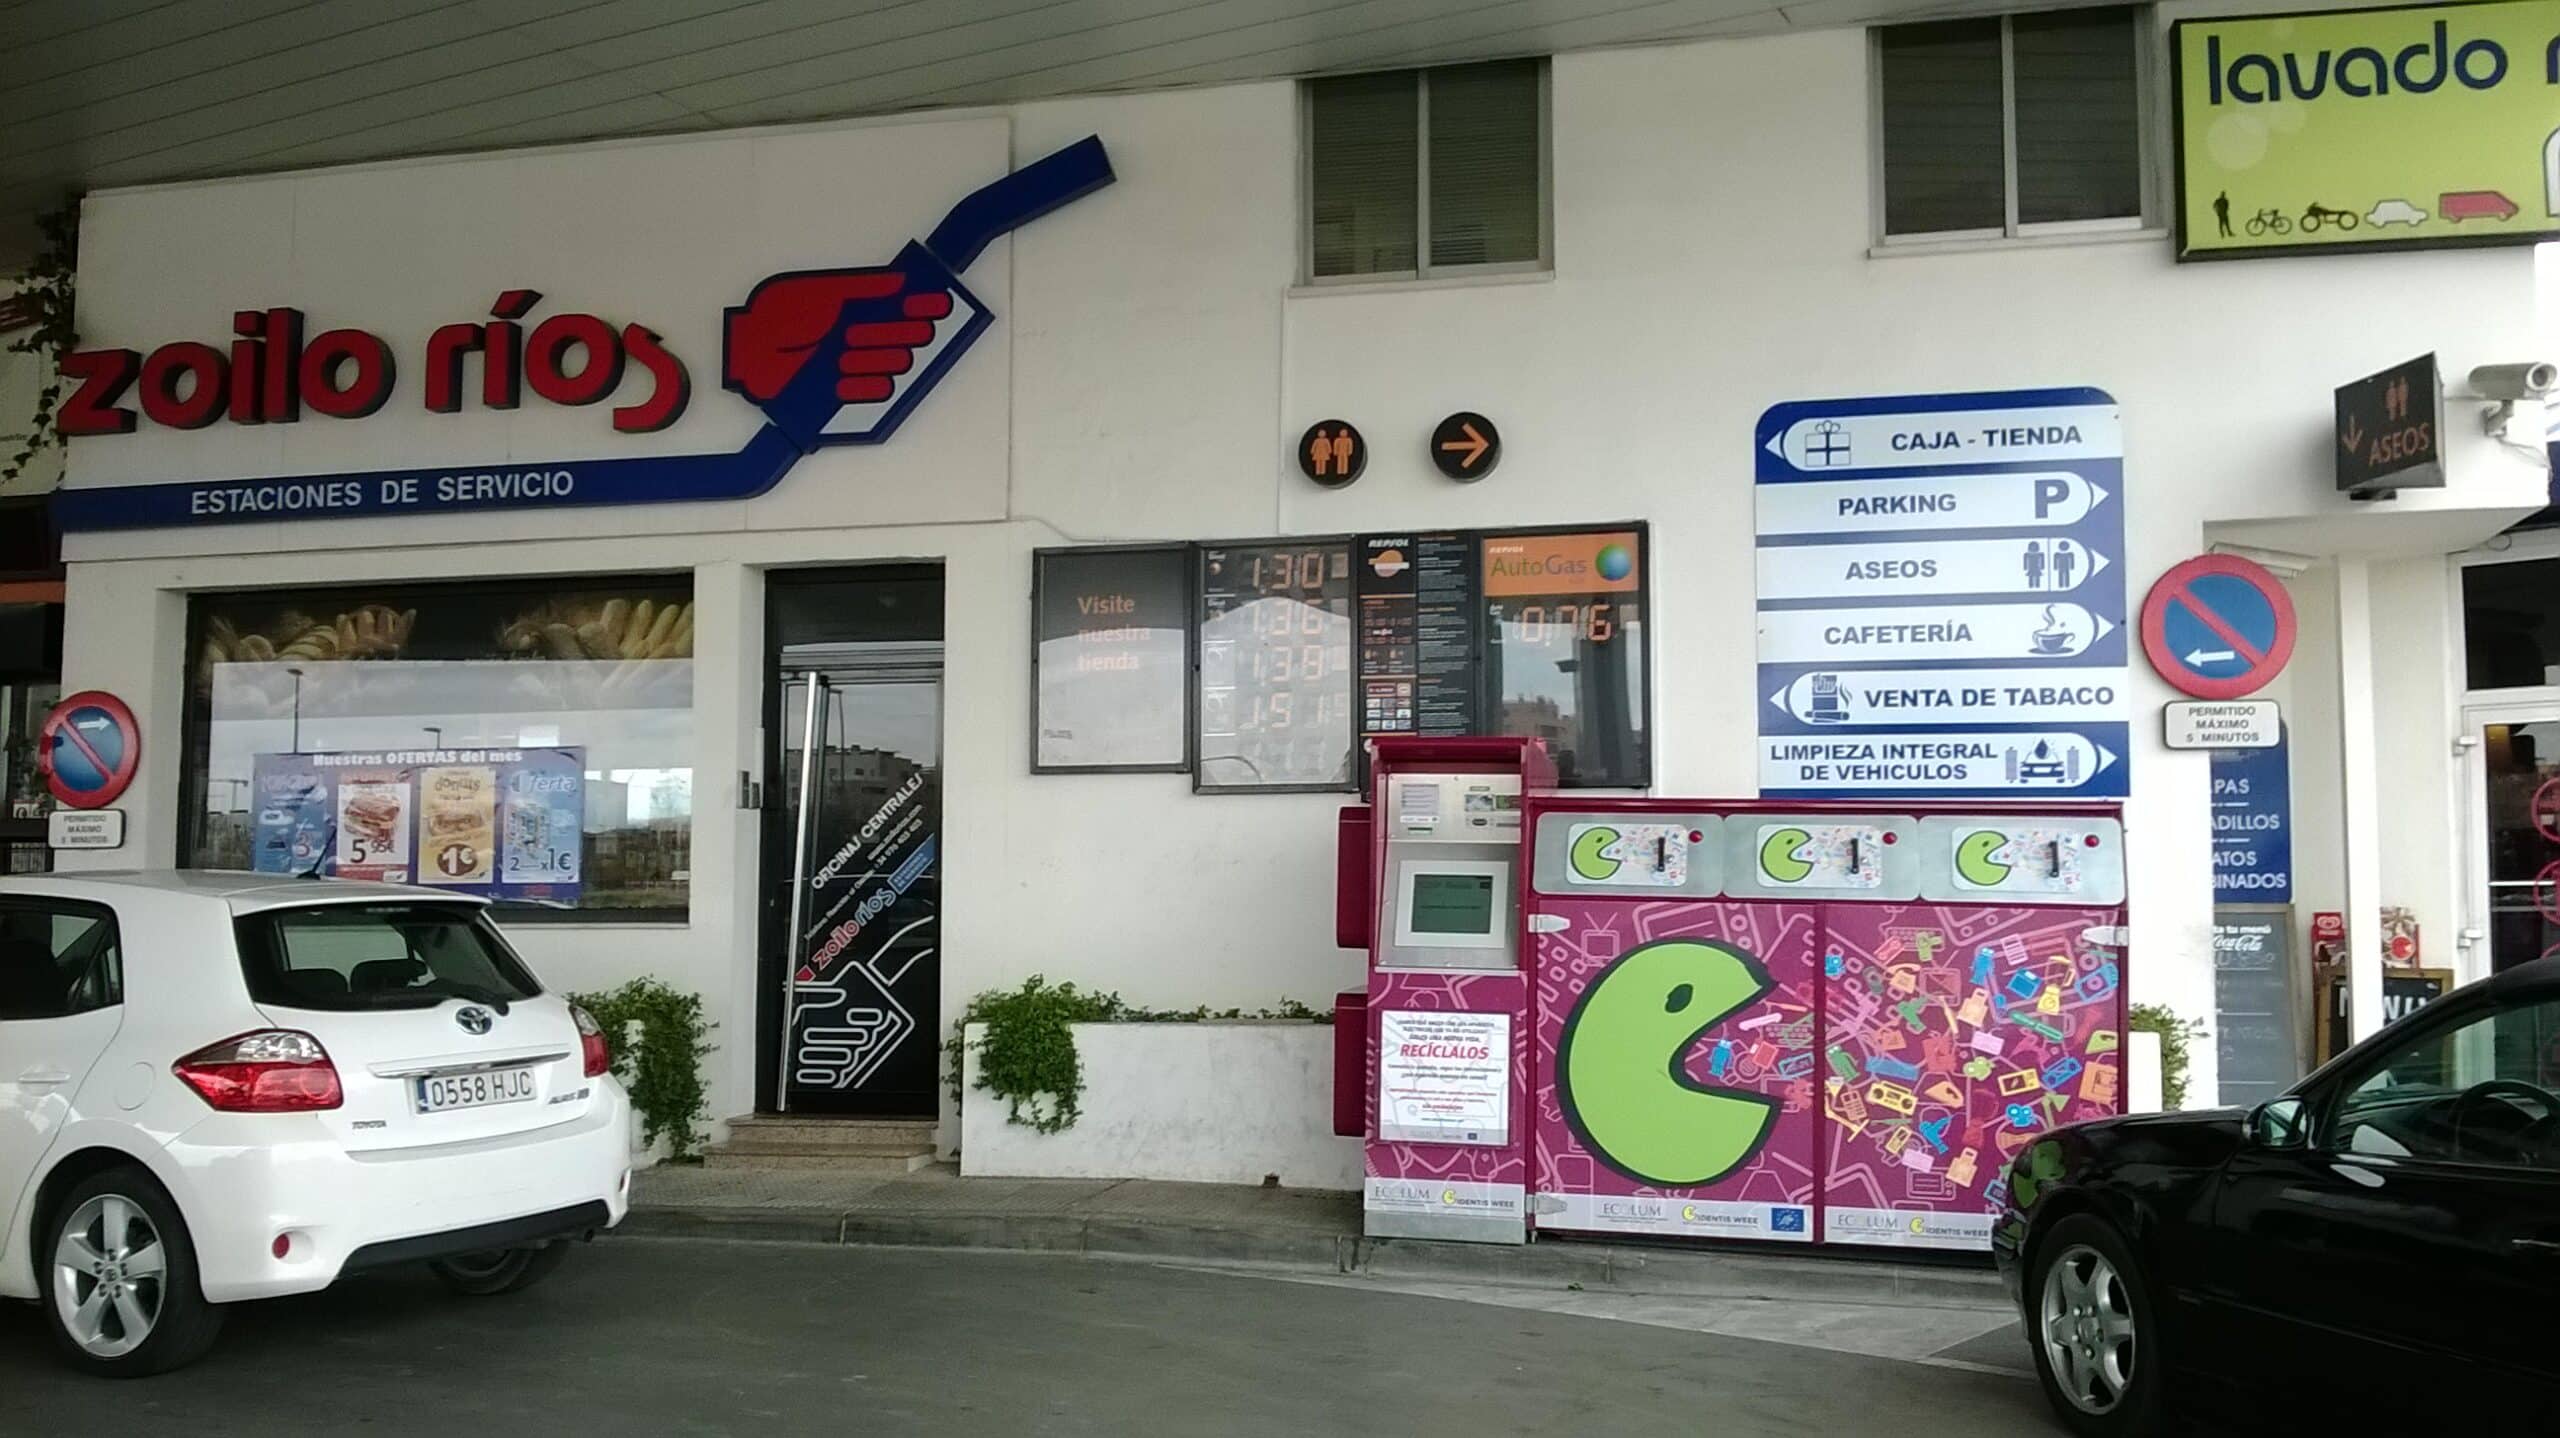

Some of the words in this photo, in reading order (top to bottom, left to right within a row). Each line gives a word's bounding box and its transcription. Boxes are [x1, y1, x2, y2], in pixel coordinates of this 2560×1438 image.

[2206, 20, 2508, 105] lavado
[57, 307, 396, 436] zoilo
[425, 289, 691, 433] ríos
[1891, 432, 1960, 450] CAJA
[1982, 426, 2083, 448] TIENDA
[2368, 422, 2430, 466] ASEOS
[191, 482, 363, 514] ESTACIONES
[381, 478, 419, 504] DE
[437, 470, 574, 502] SERVICIO
[1838, 493, 1957, 516] PARKING
[1490, 553, 1587, 577] AutoGas
[1845, 559, 1938, 580] ASEOS
[1077, 595, 1136, 615] Visite
[1078, 623, 1151, 643] nuestra
[1823, 620, 1973, 645] CAFETERÍA
[1077, 652, 1140, 672] tienda
[1864, 689, 1954, 708] VENTA
[1961, 688, 1997, 707] DE
[2004, 686, 2115, 706] TABACO
[2188, 706, 2256, 717] PERMITIDO
[2196, 717, 2249, 729] MÁXIMO
[2201, 732, 2260, 743] MINUTOS
[313, 754, 383, 766] Nuestras
[386, 751, 457, 764] OFERTAS
[460, 750, 484, 763] del
[489, 752, 523, 763] mes
[1770, 744, 1876, 761] LIMPIEZA
[1882, 743, 1998, 760] INTEGRAL
[1801, 765, 1830, 781] DE
[1836, 763, 1968, 781] VEHICULOS
[2214, 778, 2250, 794] PAS
[811, 835, 862, 889] OFICINAS
[860, 772, 924, 838] CENTRALES
[350, 838, 367, 864] 5
[1399, 1043, 1490, 1061] RECÍCLALOS
[431, 1076, 487, 1107] 0558
[492, 1071, 533, 1100] HJC
